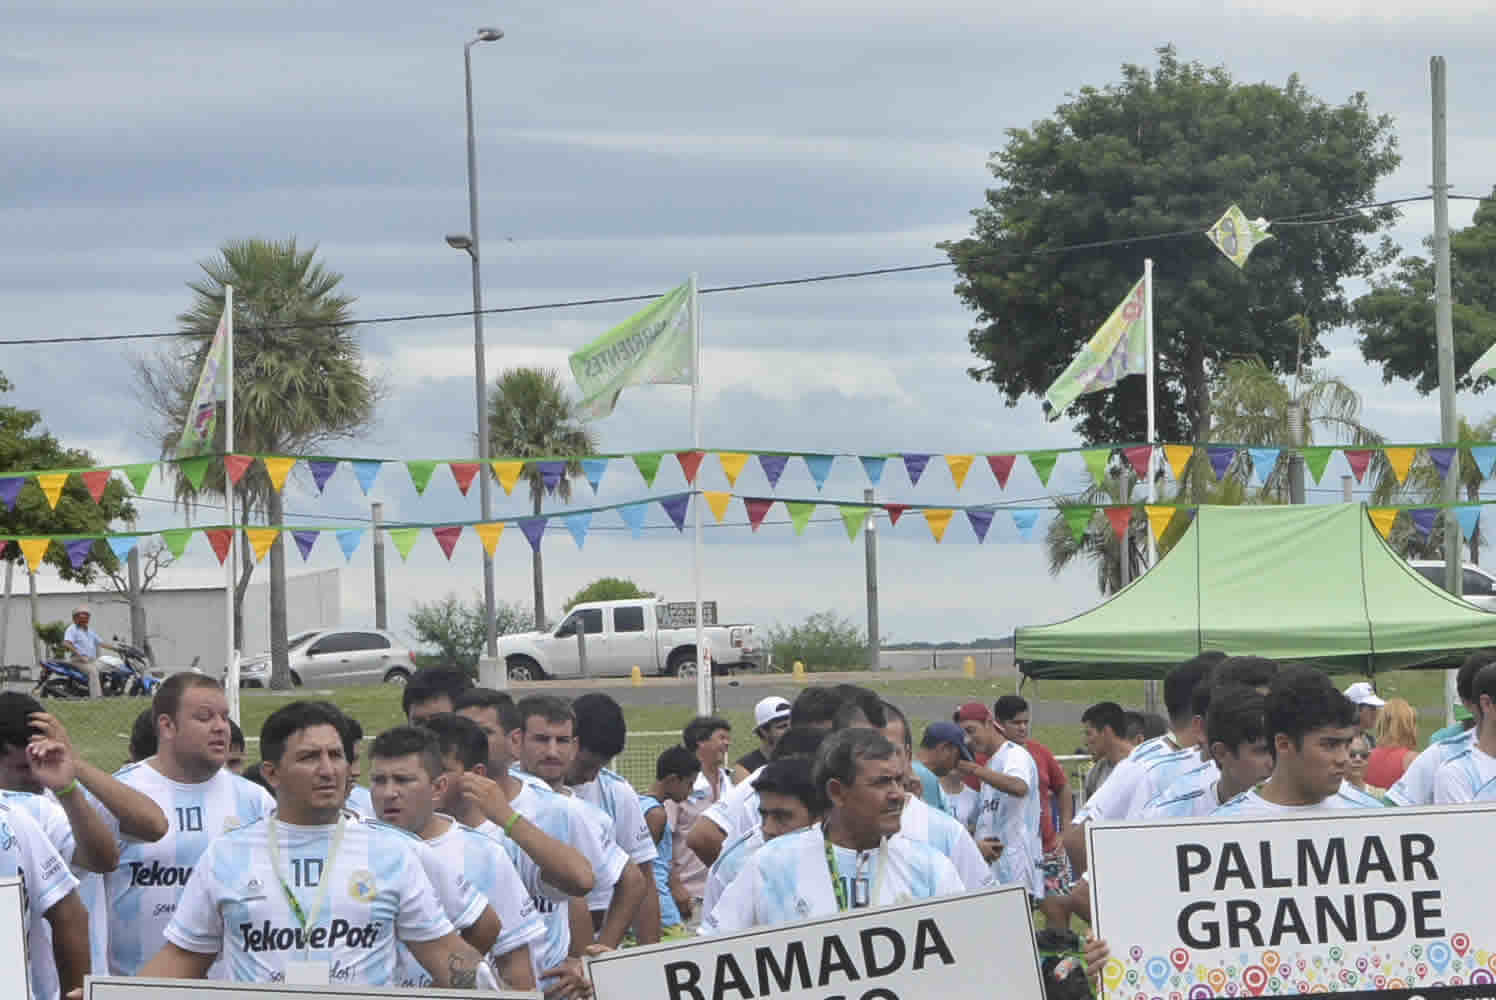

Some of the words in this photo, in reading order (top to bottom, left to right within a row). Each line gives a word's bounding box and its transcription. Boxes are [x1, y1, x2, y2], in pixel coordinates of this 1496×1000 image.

[175, 806, 204, 832] 10
[291, 858, 324, 888] 10
[1176, 834, 1440, 893] PALMAR
[1177, 890, 1446, 950] GRANDE
